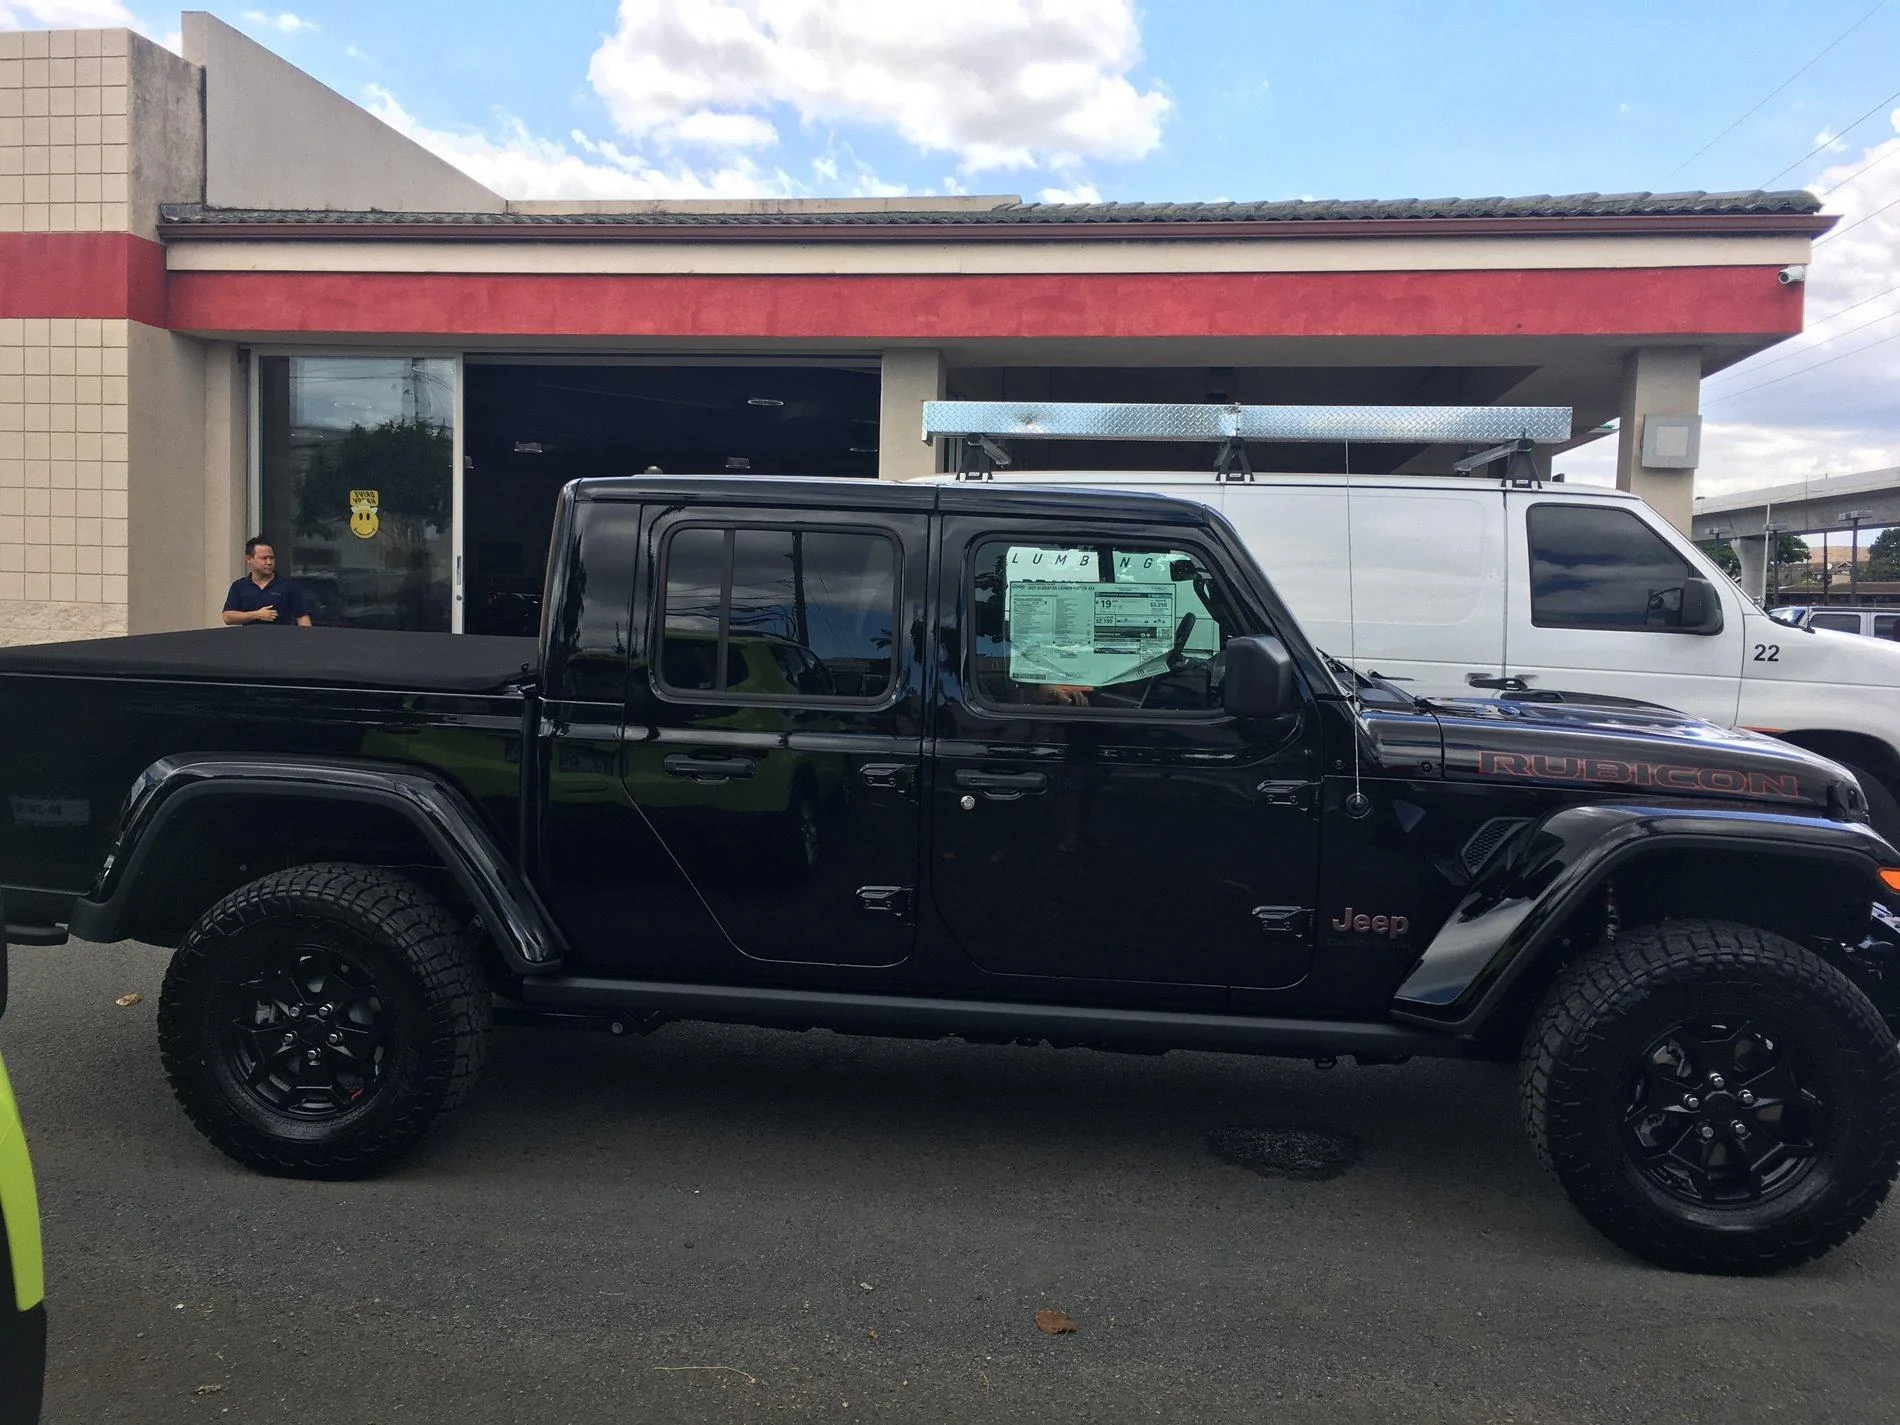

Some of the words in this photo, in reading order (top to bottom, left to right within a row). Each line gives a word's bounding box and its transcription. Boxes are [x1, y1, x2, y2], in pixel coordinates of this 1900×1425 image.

[1101, 600, 1112, 608] 19
[1753, 644, 1780, 661] 22
[1478, 750, 1800, 798] RUBICON
[1332, 907, 1409, 939] Jeep
